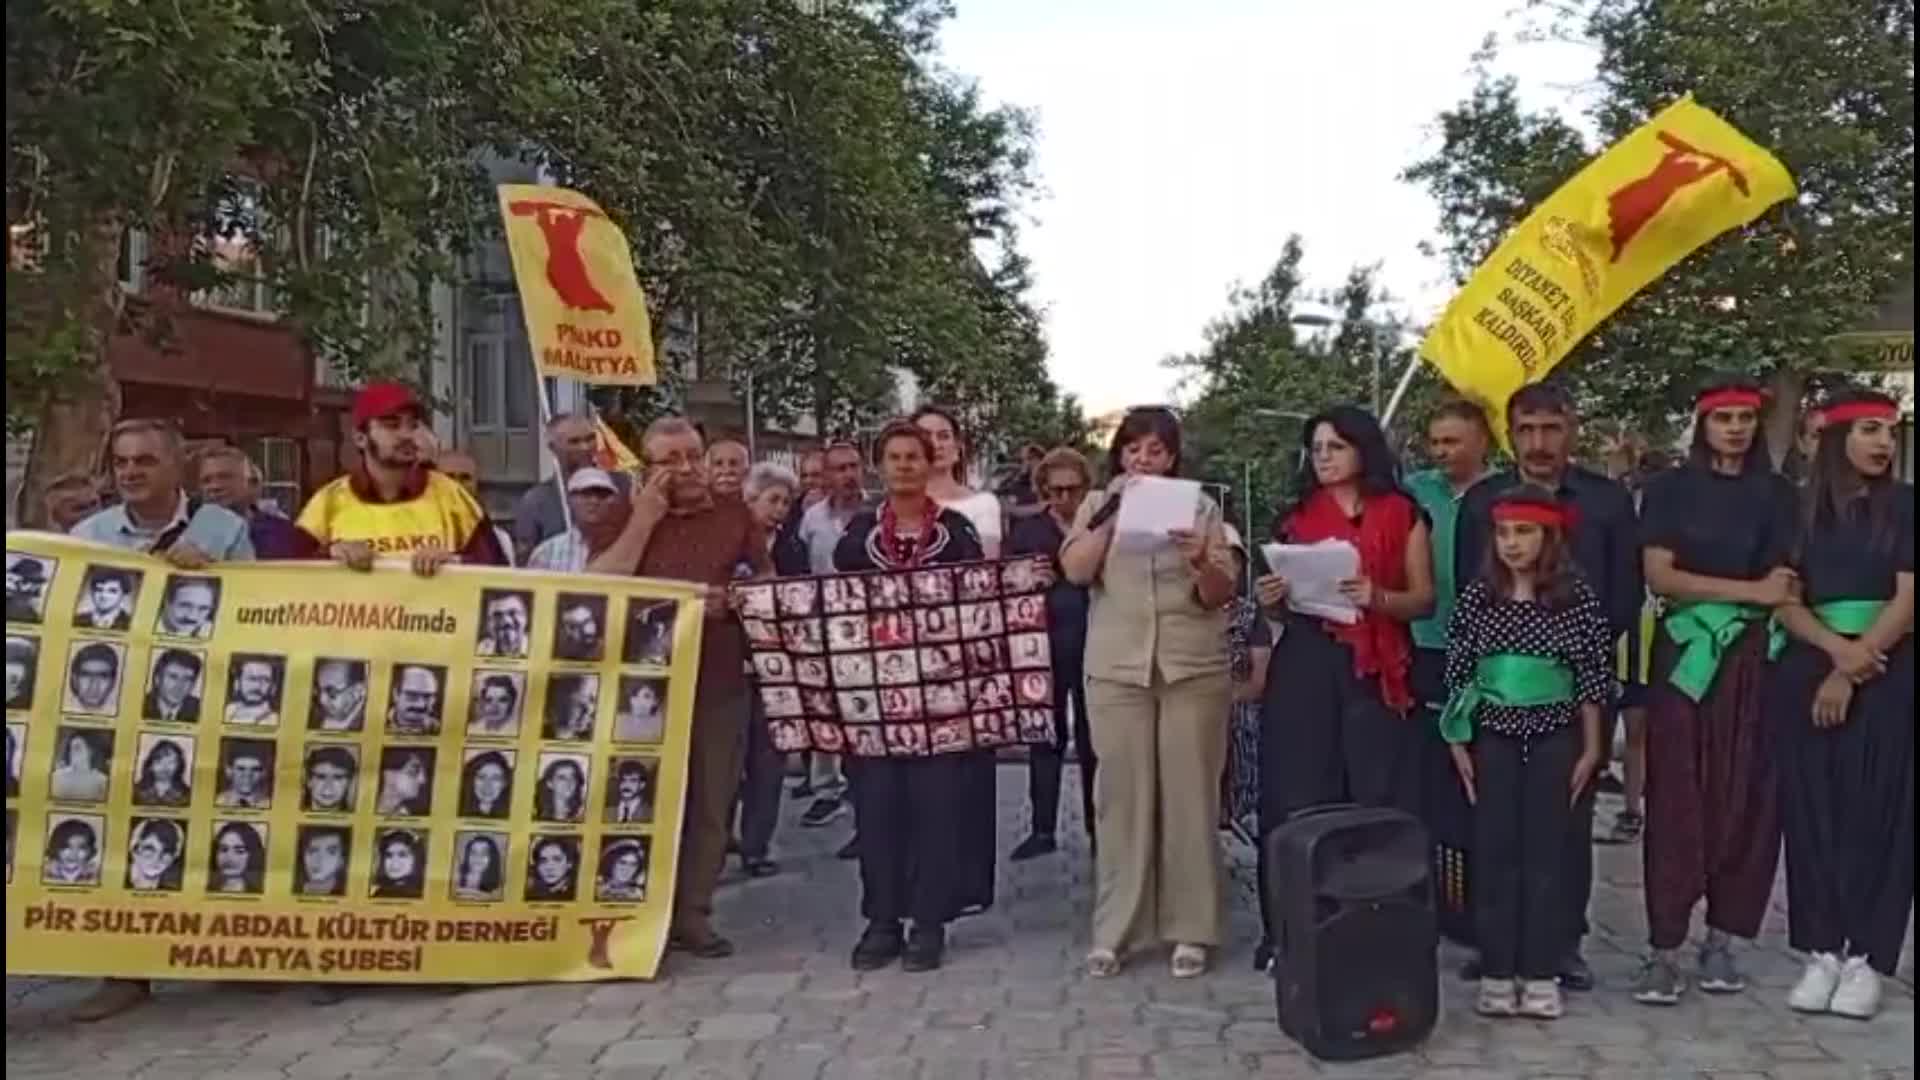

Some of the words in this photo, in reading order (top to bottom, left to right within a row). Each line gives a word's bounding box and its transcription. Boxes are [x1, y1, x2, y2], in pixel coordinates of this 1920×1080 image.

[24, 900, 74, 931] PİR
[81, 907, 200, 935] SULTAN
[208, 913, 311, 939] ABDAL
[316, 912, 428, 942] KÜLTÜR
[435, 915, 558, 943] DERNEĞİ
[168, 945, 313, 970] MALATYA
[318, 945, 422, 974] ŞUBESİ
